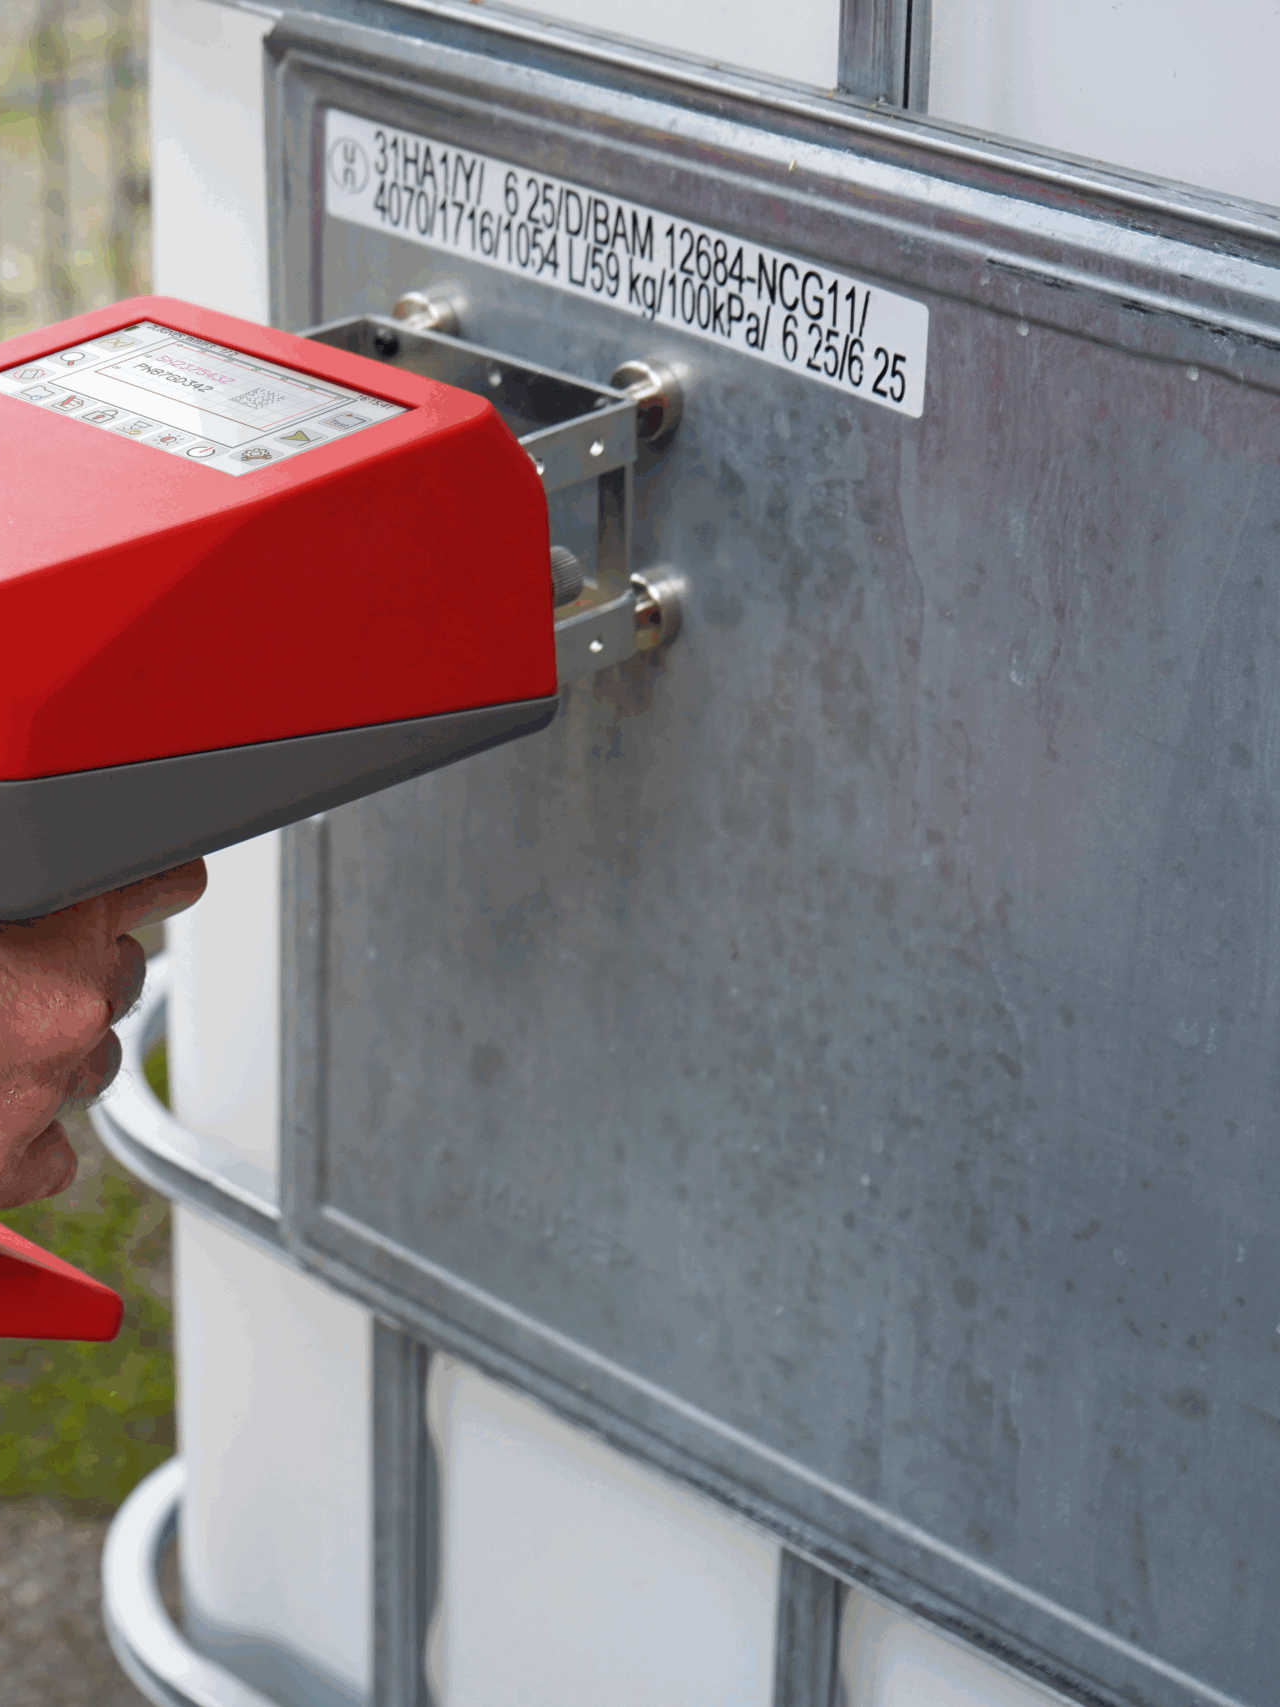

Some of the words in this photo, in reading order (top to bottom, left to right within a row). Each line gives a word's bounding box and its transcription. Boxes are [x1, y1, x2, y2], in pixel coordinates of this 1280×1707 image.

[373, 180, 560, 278] 4070/1716/1054
[568, 238, 621, 298] L/59
[628, 257, 772, 352] kg/100kPa/
[782, 314, 799, 363] 6
[806, 323, 865, 387] 25/6
[872, 346, 907, 403] 25
[504, 170, 519, 217] 6
[526, 178, 654, 263] 25/D/BAM
[666, 223, 871, 338] 12684-NCG11/
